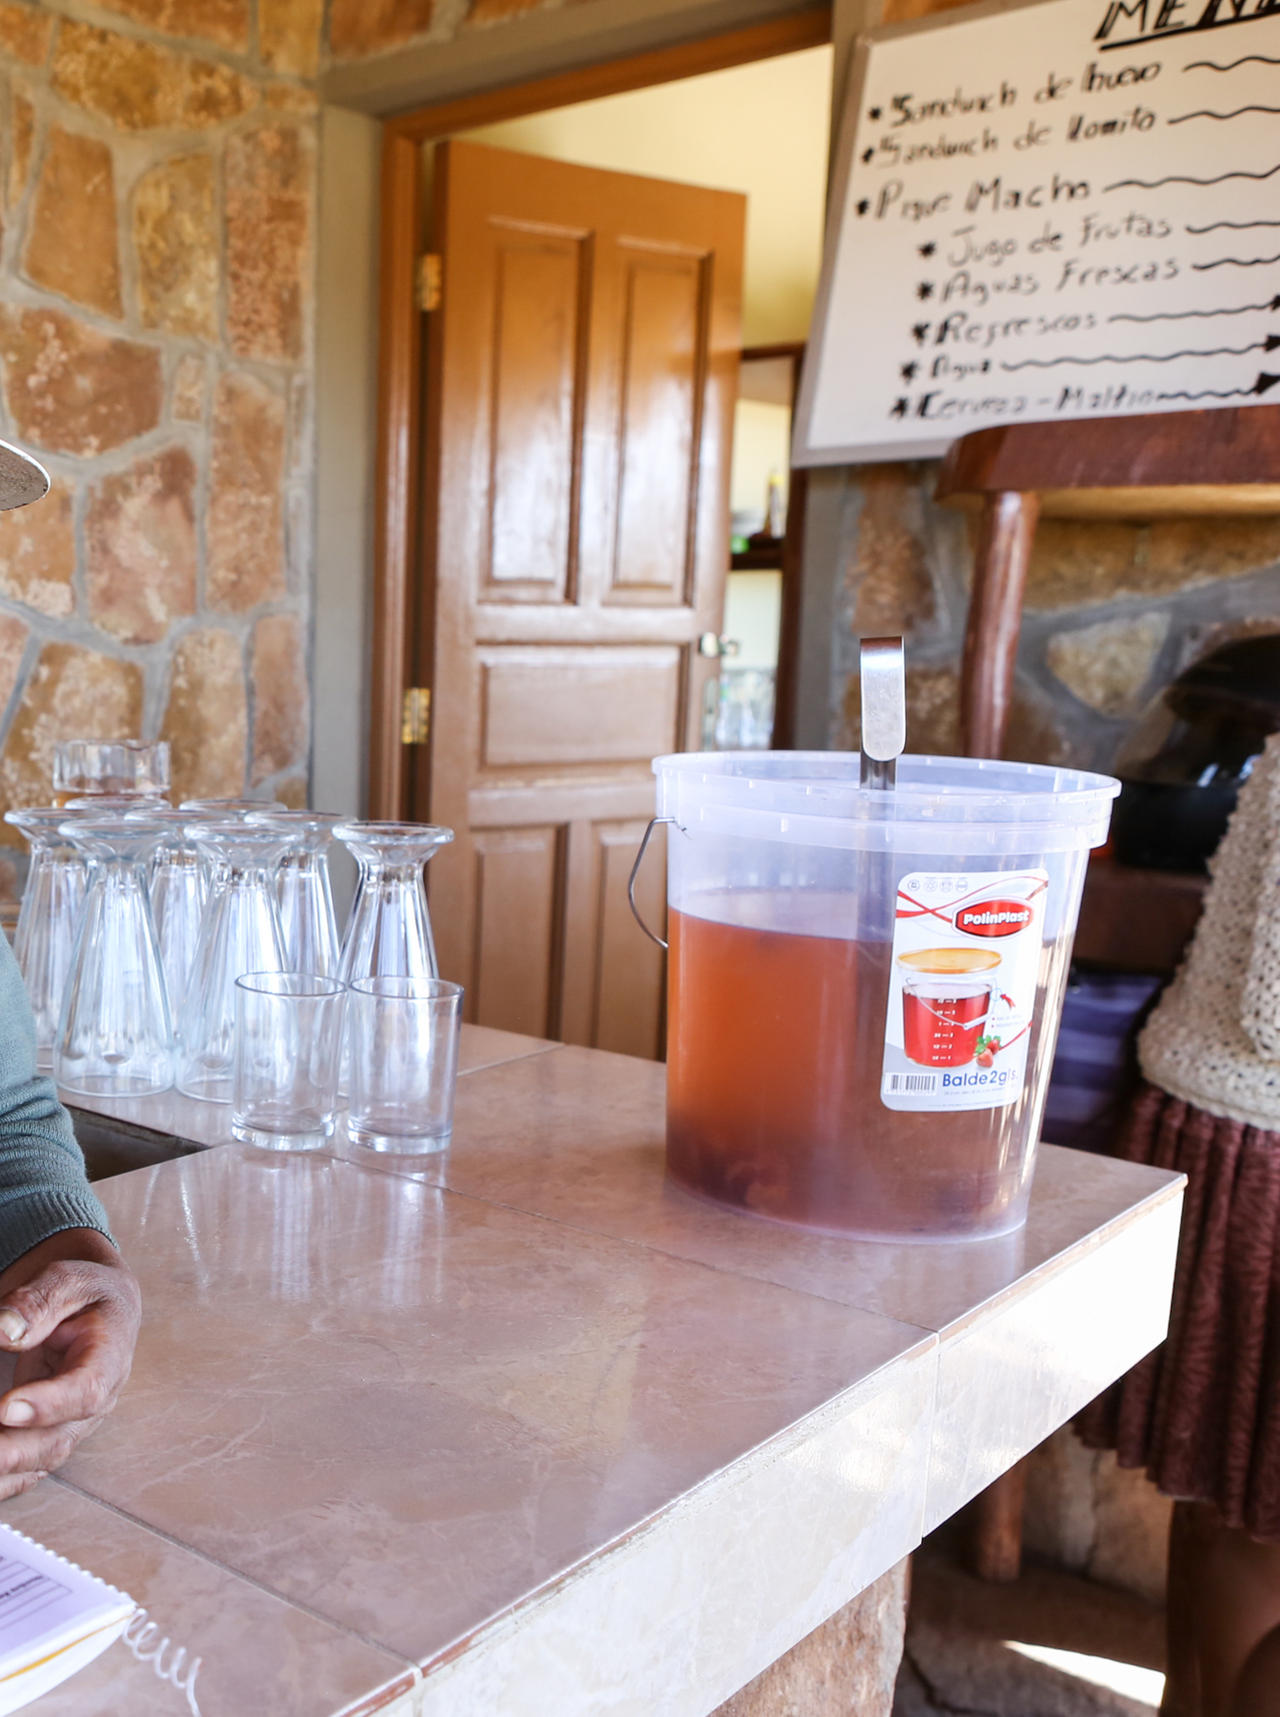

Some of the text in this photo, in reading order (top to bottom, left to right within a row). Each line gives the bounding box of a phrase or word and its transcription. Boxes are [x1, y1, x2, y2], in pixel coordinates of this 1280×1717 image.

[1033, 71, 1073, 104] de
[1013, 118, 1053, 151] de
[947, 208, 1173, 267] Jugo de Frutas
[940, 257, 1180, 306] Aguas Frescas
[963, 909, 1030, 925] PolinPlast
[942, 1072, 988, 1087] Balde
